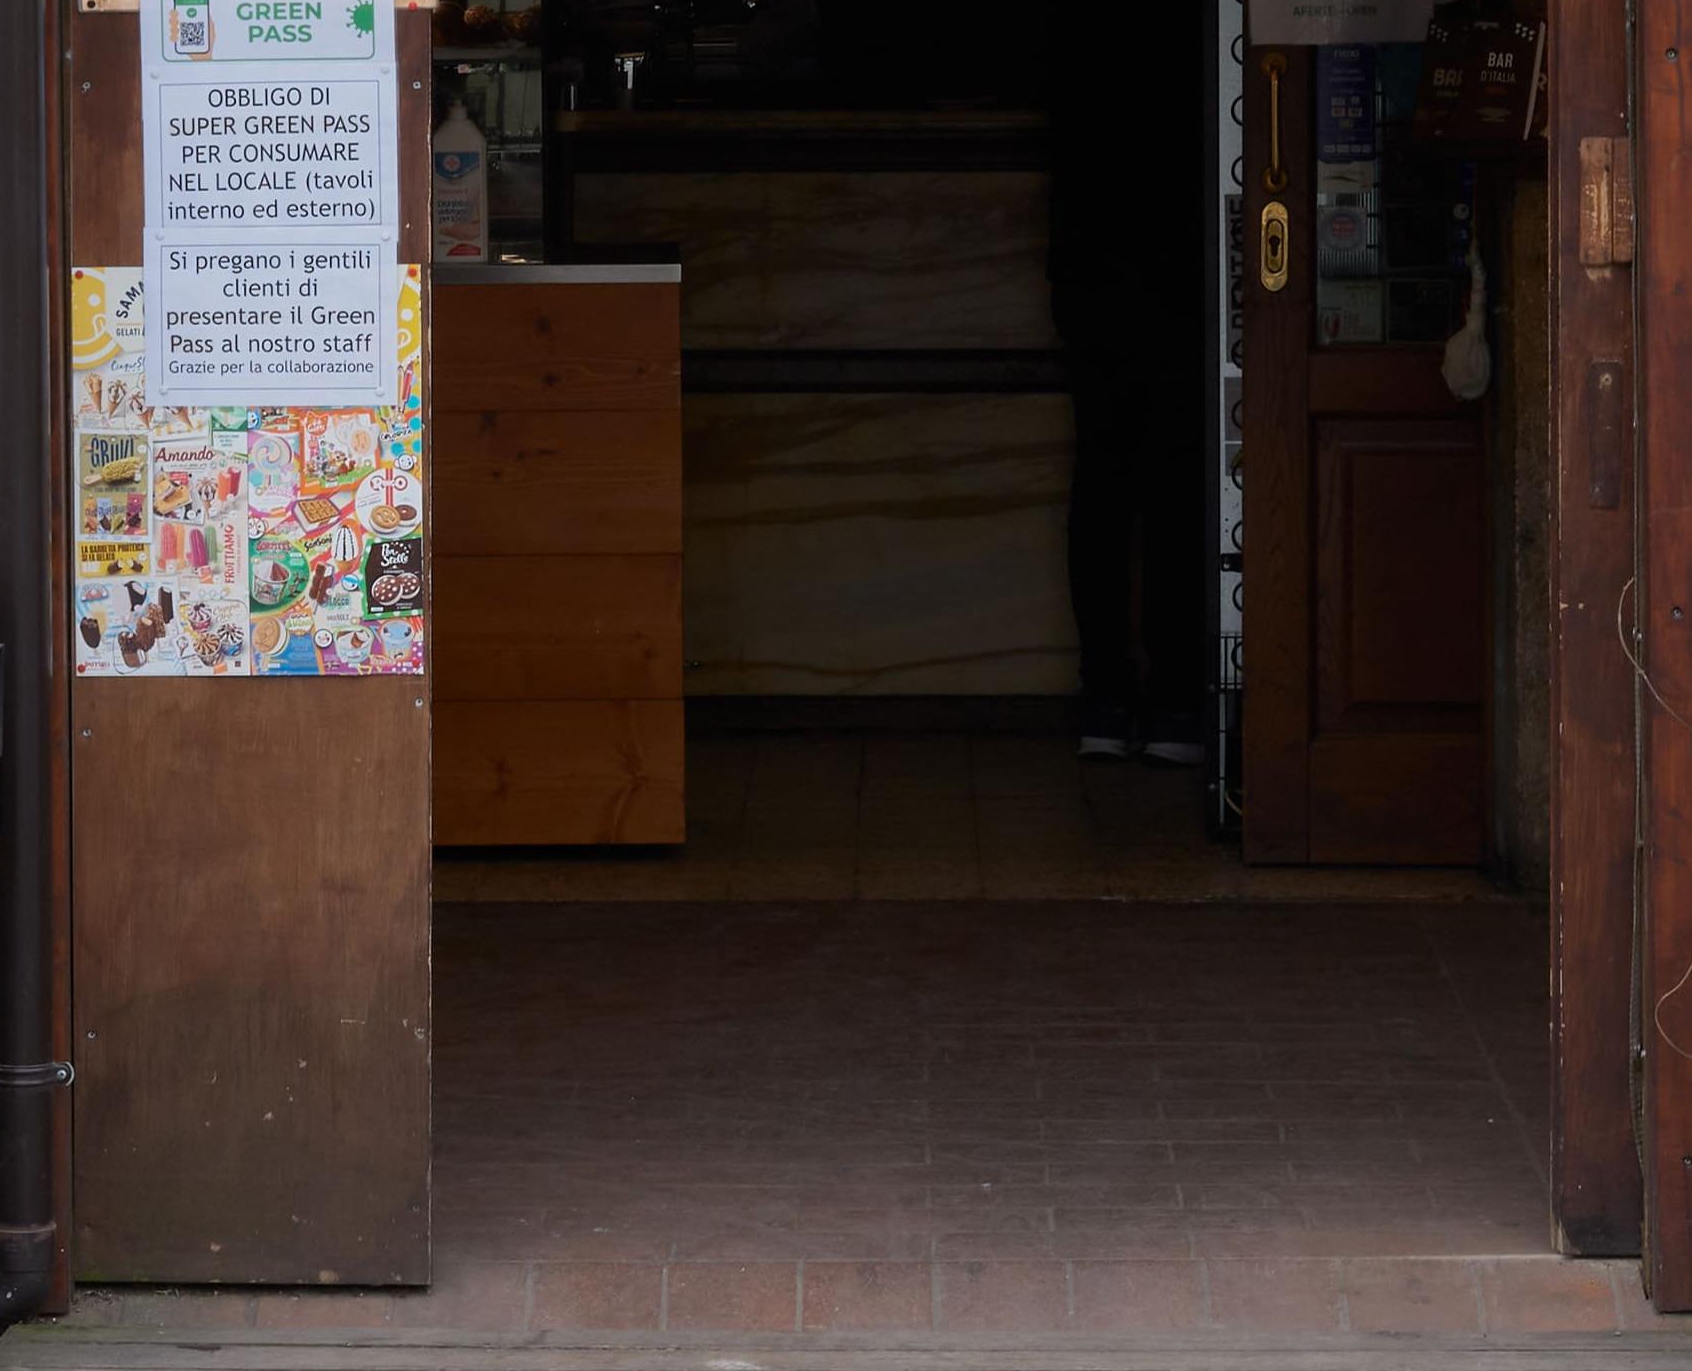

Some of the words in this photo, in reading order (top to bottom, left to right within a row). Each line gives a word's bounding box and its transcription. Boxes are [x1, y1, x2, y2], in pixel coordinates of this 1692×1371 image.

[236, 2, 322, 20] GREEN
[248, 25, 313, 43] PASS
[1487, 52, 1514, 67] BAR
[208, 87, 302, 107] OBBLIGO
[311, 87, 330, 105] DI
[170, 117, 236, 136] SUPER
[244, 115, 314, 134] GREEN
[324, 115, 370, 133] PASS
[183, 145, 221, 164] PER
[229, 143, 359, 163] CONSUMARE
[170, 173, 208, 192] NEL
[216, 171, 296, 191] LOCALE
[306, 170, 373, 193] (tavoli
[168, 202, 244, 220] interno
[253, 199, 278, 218] ed
[287, 199, 375, 220] esterno)
[170, 251, 187, 270] Si
[196, 255, 281, 274] pregano
[290, 250, 295, 269] i
[304, 250, 371, 274] gentili
[223, 278, 290, 297] clienti
[299, 278, 318, 297] di
[167, 308, 282, 330] presentare
[290, 306, 303, 324] il
[311, 306, 375, 324] Green
[116, 327, 140, 336] GELATI
[170, 335, 213, 353] Pass
[222, 334, 240, 353] al
[248, 336, 315, 353] nostro
[323, 333, 373, 353] staff
[169, 360, 215, 374] Grazie
[221, 363, 244, 376] per
[249, 360, 262, 374] la
[267, 360, 374, 374] collaborazione
